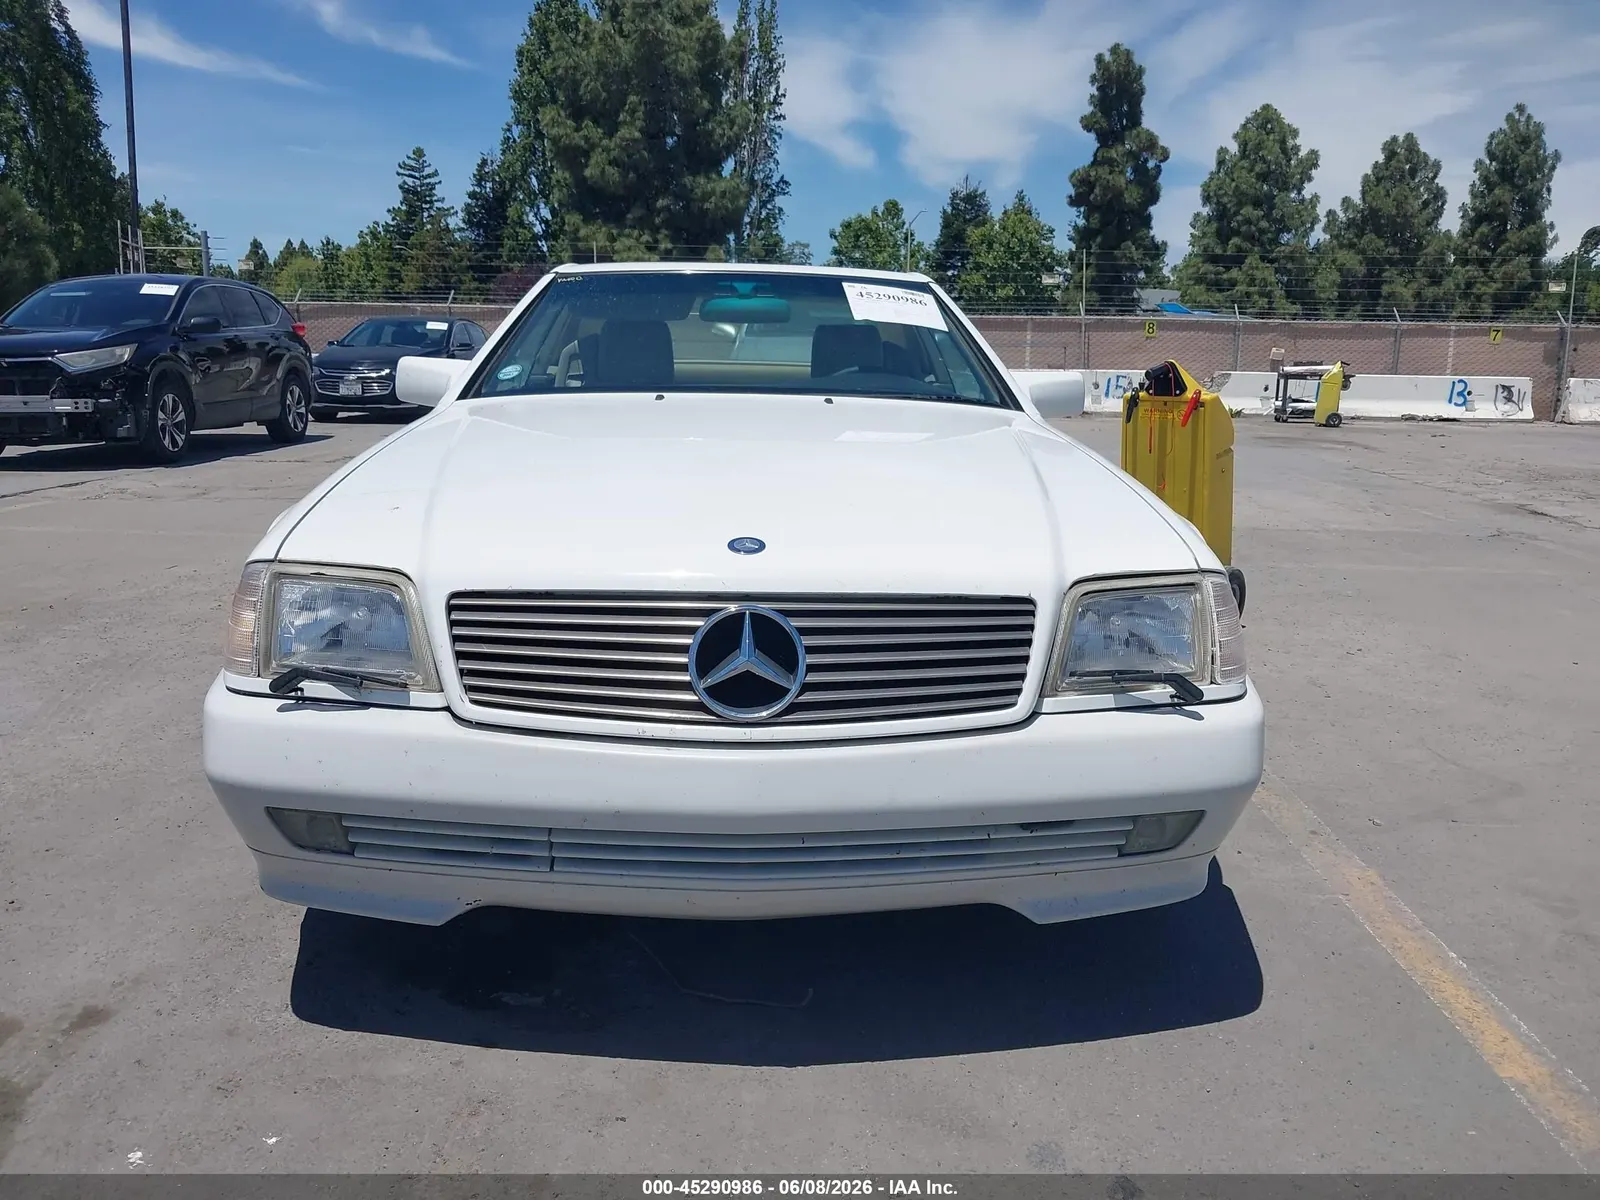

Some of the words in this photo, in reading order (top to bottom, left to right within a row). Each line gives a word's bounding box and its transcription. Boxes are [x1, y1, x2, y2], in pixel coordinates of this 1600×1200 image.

[855, 290, 928, 307] 45290986
[1147, 322, 1155, 335] 8
[1492, 329, 1501, 341] 7
[1448, 378, 1468, 406] 13
